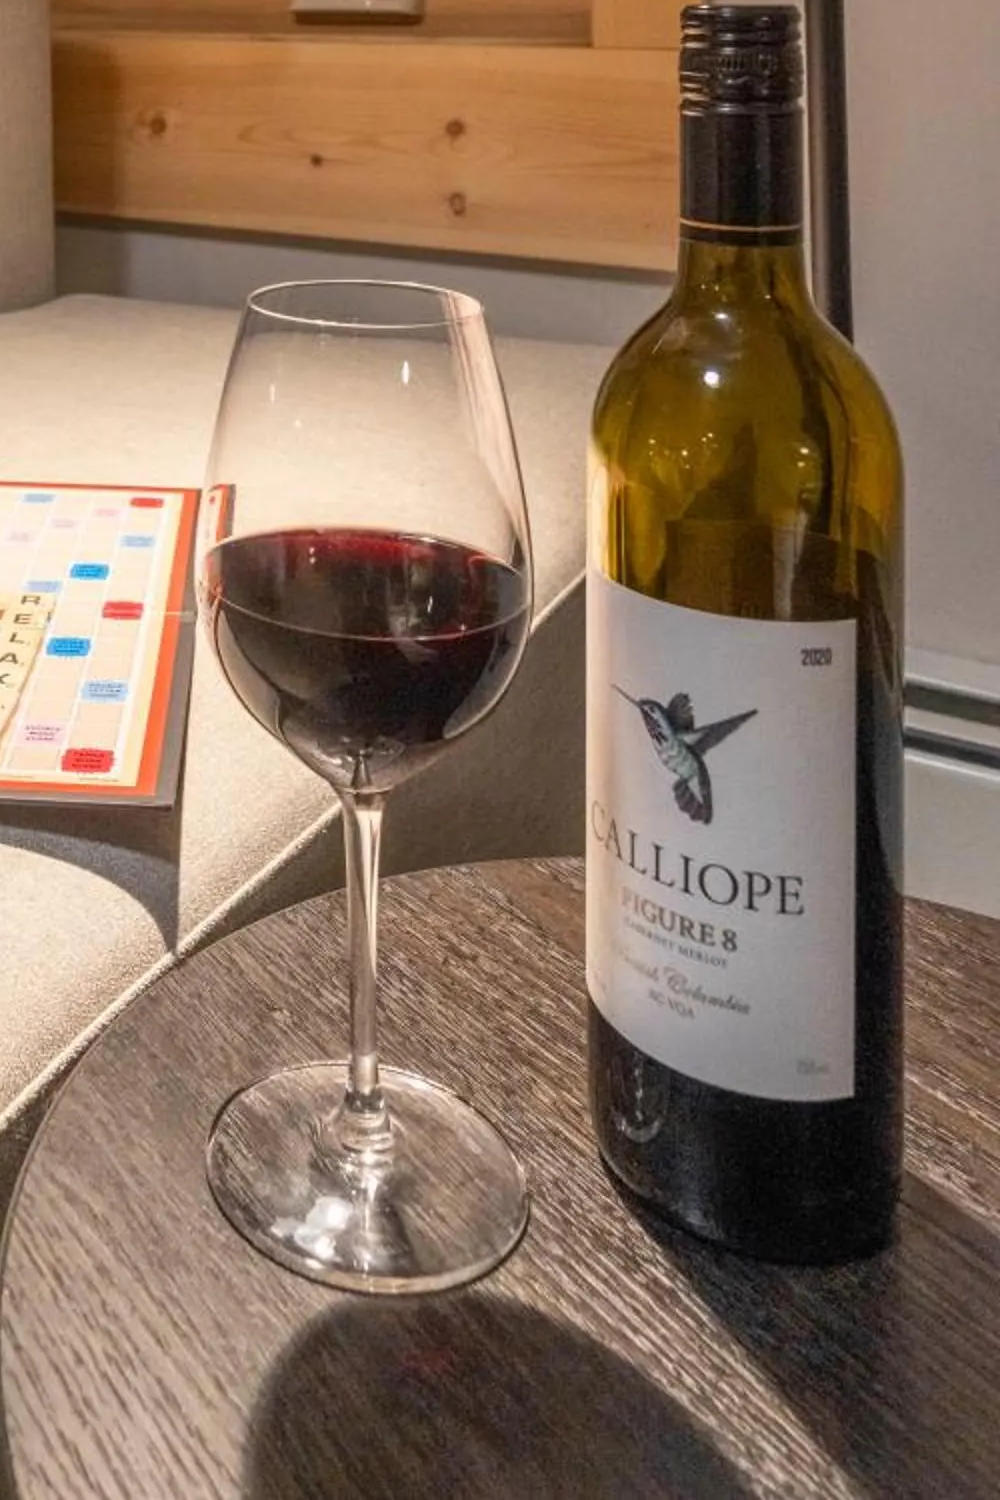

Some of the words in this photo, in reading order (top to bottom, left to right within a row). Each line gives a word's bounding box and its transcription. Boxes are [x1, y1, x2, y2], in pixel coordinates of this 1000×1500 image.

[801, 648, 832, 666] 2020
[591, 799, 805, 915] CALLIOPE
[621, 886, 716, 947] FIGURE
[721, 928, 738, 953] 8
